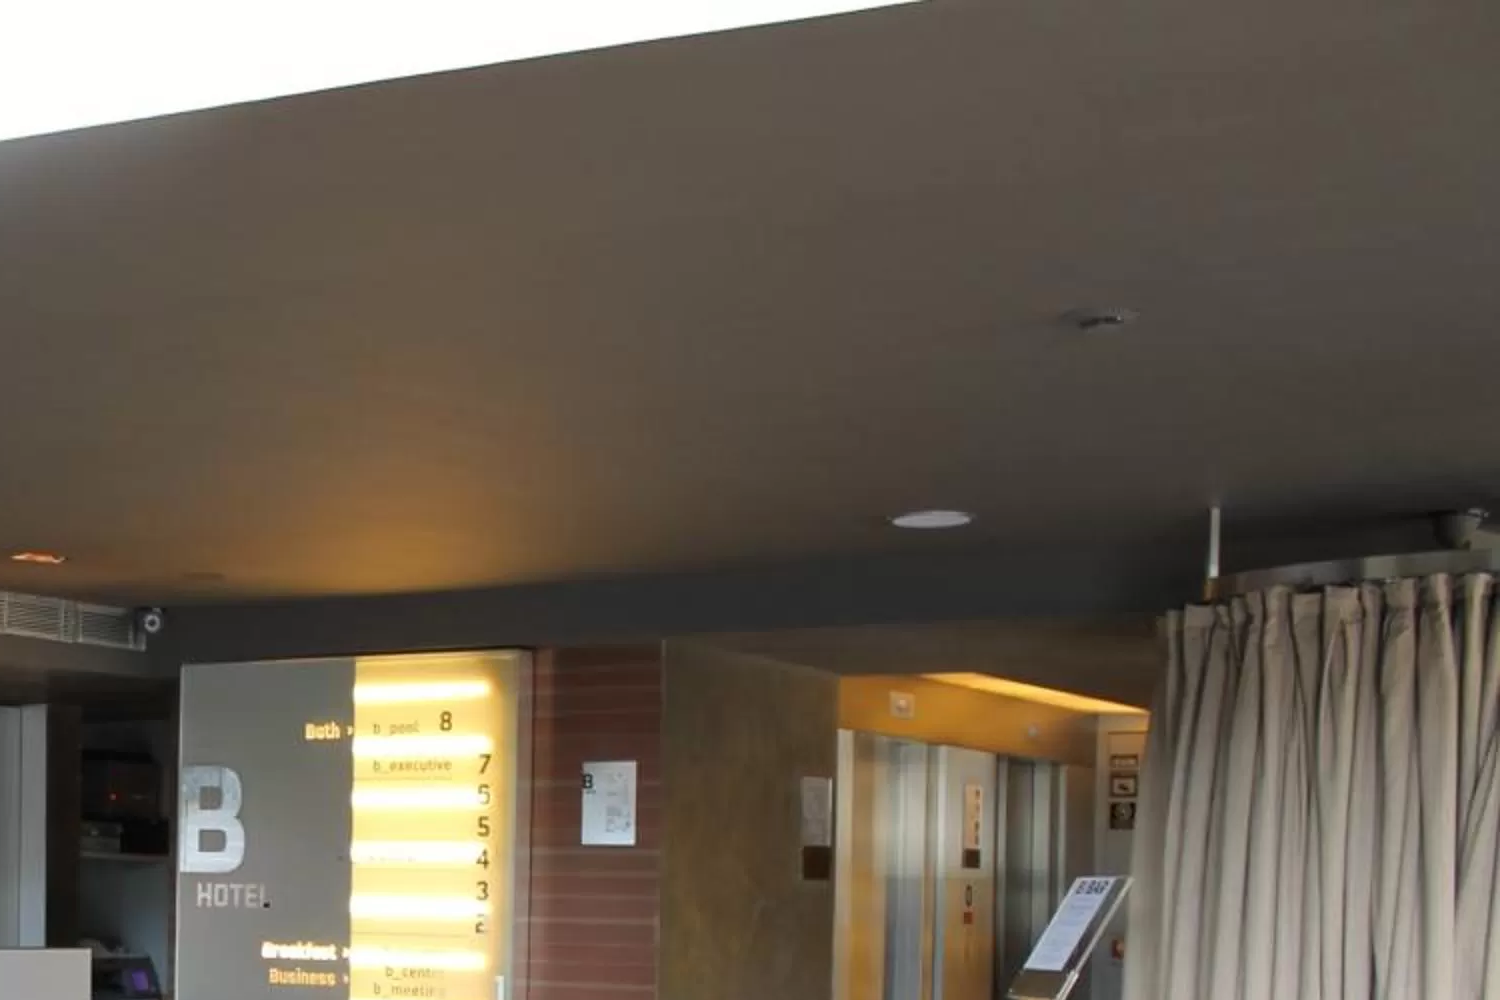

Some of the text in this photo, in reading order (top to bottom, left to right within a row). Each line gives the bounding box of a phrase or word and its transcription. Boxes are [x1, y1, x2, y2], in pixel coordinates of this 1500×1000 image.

[439, 710, 453, 732] 8
[478, 753, 492, 775] 7
[179, 765, 245, 873] B
[476, 815, 491, 837] 5
[475, 848, 490, 870] 4
[197, 881, 267, 908] HOTEL
[475, 880, 490, 901] 3
[269, 967, 336, 987] Business
